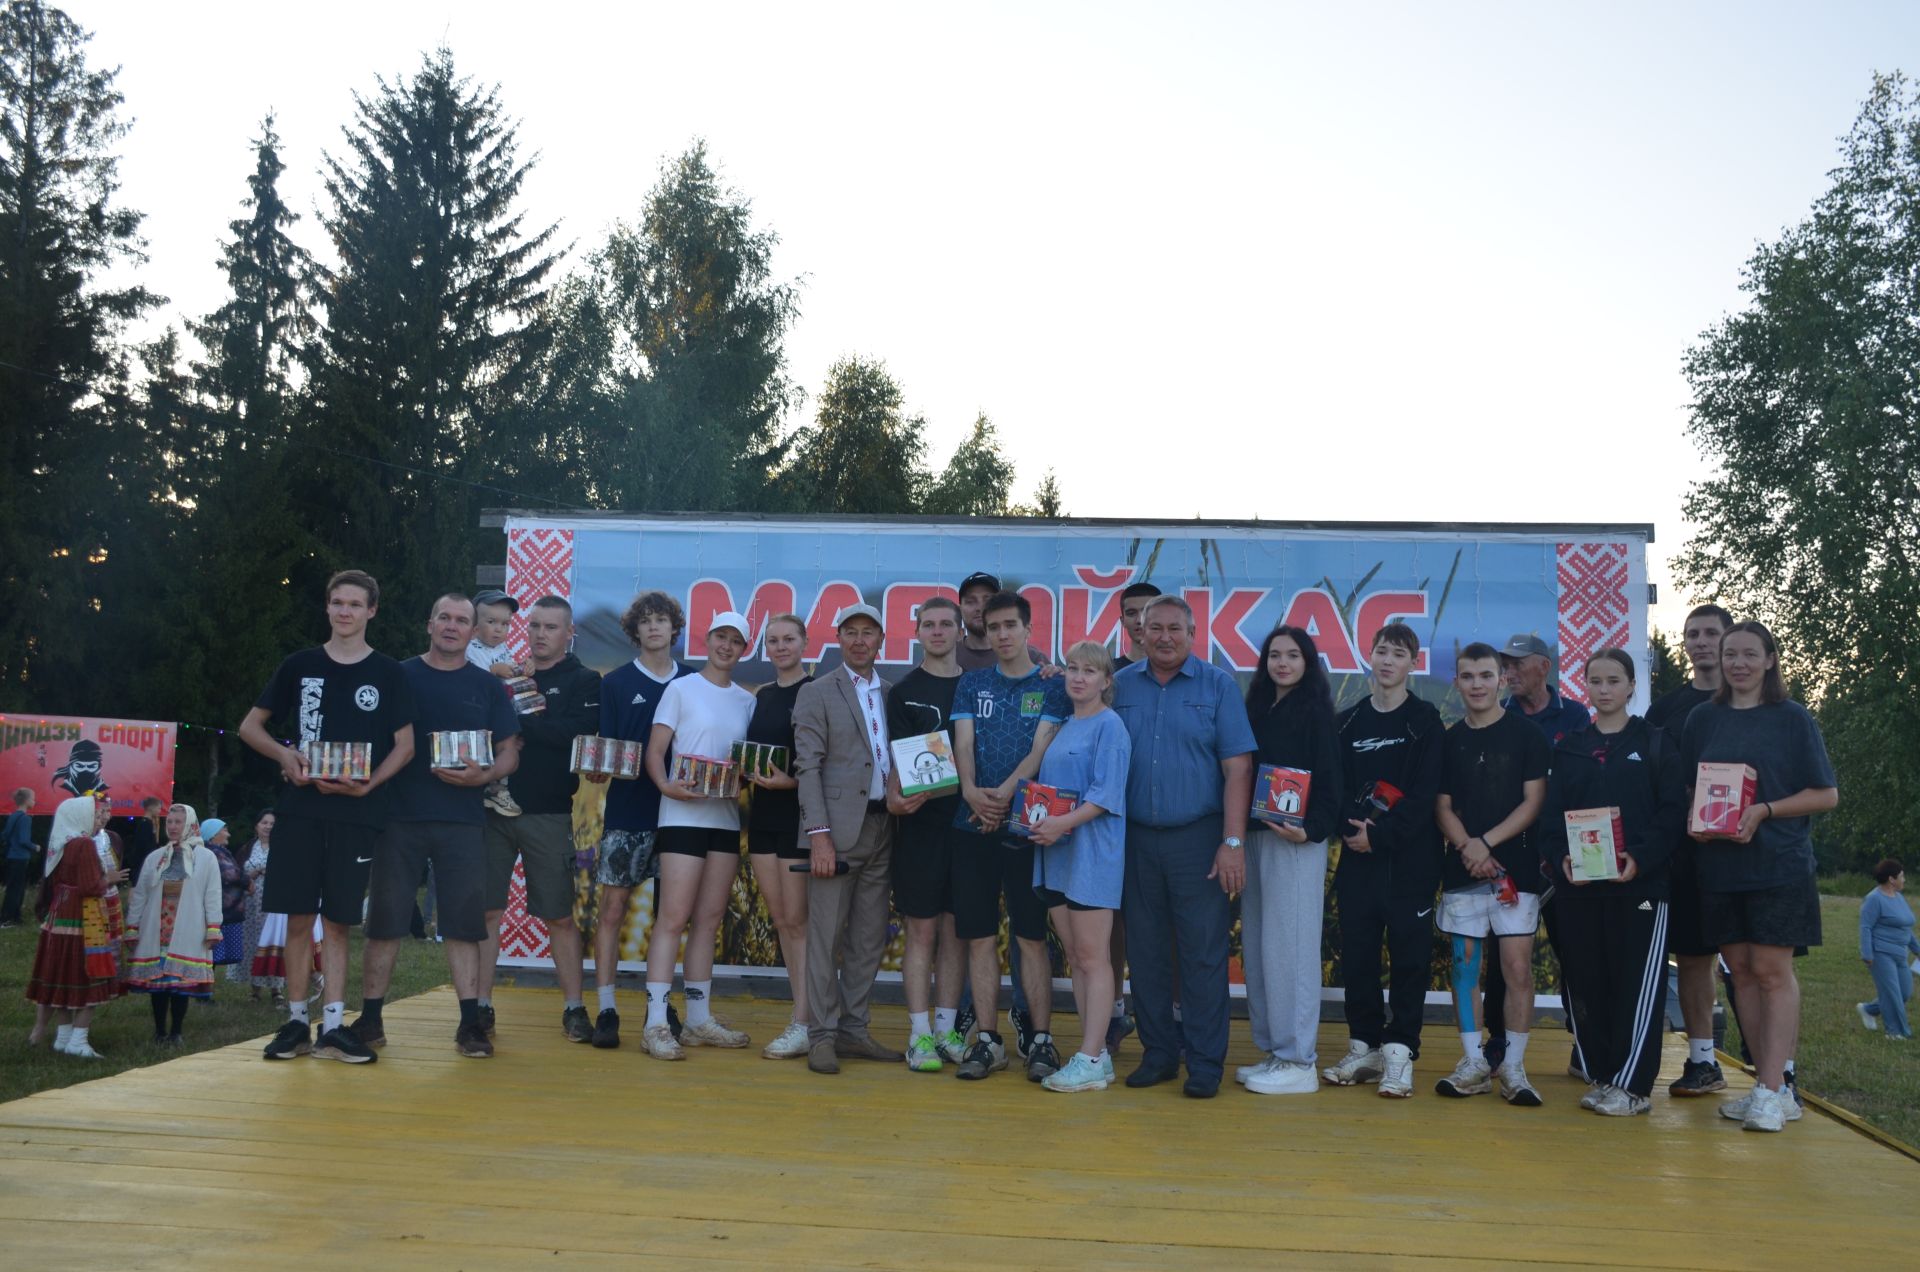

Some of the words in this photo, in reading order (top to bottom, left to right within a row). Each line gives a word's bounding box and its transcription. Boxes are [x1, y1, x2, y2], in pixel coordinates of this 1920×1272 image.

[1180, 585, 1431, 675] КАС
[976, 698, 994, 718] 10
[0, 720, 81, 752] ИНДЗЯ
[98, 723, 169, 762] СПОРТ
